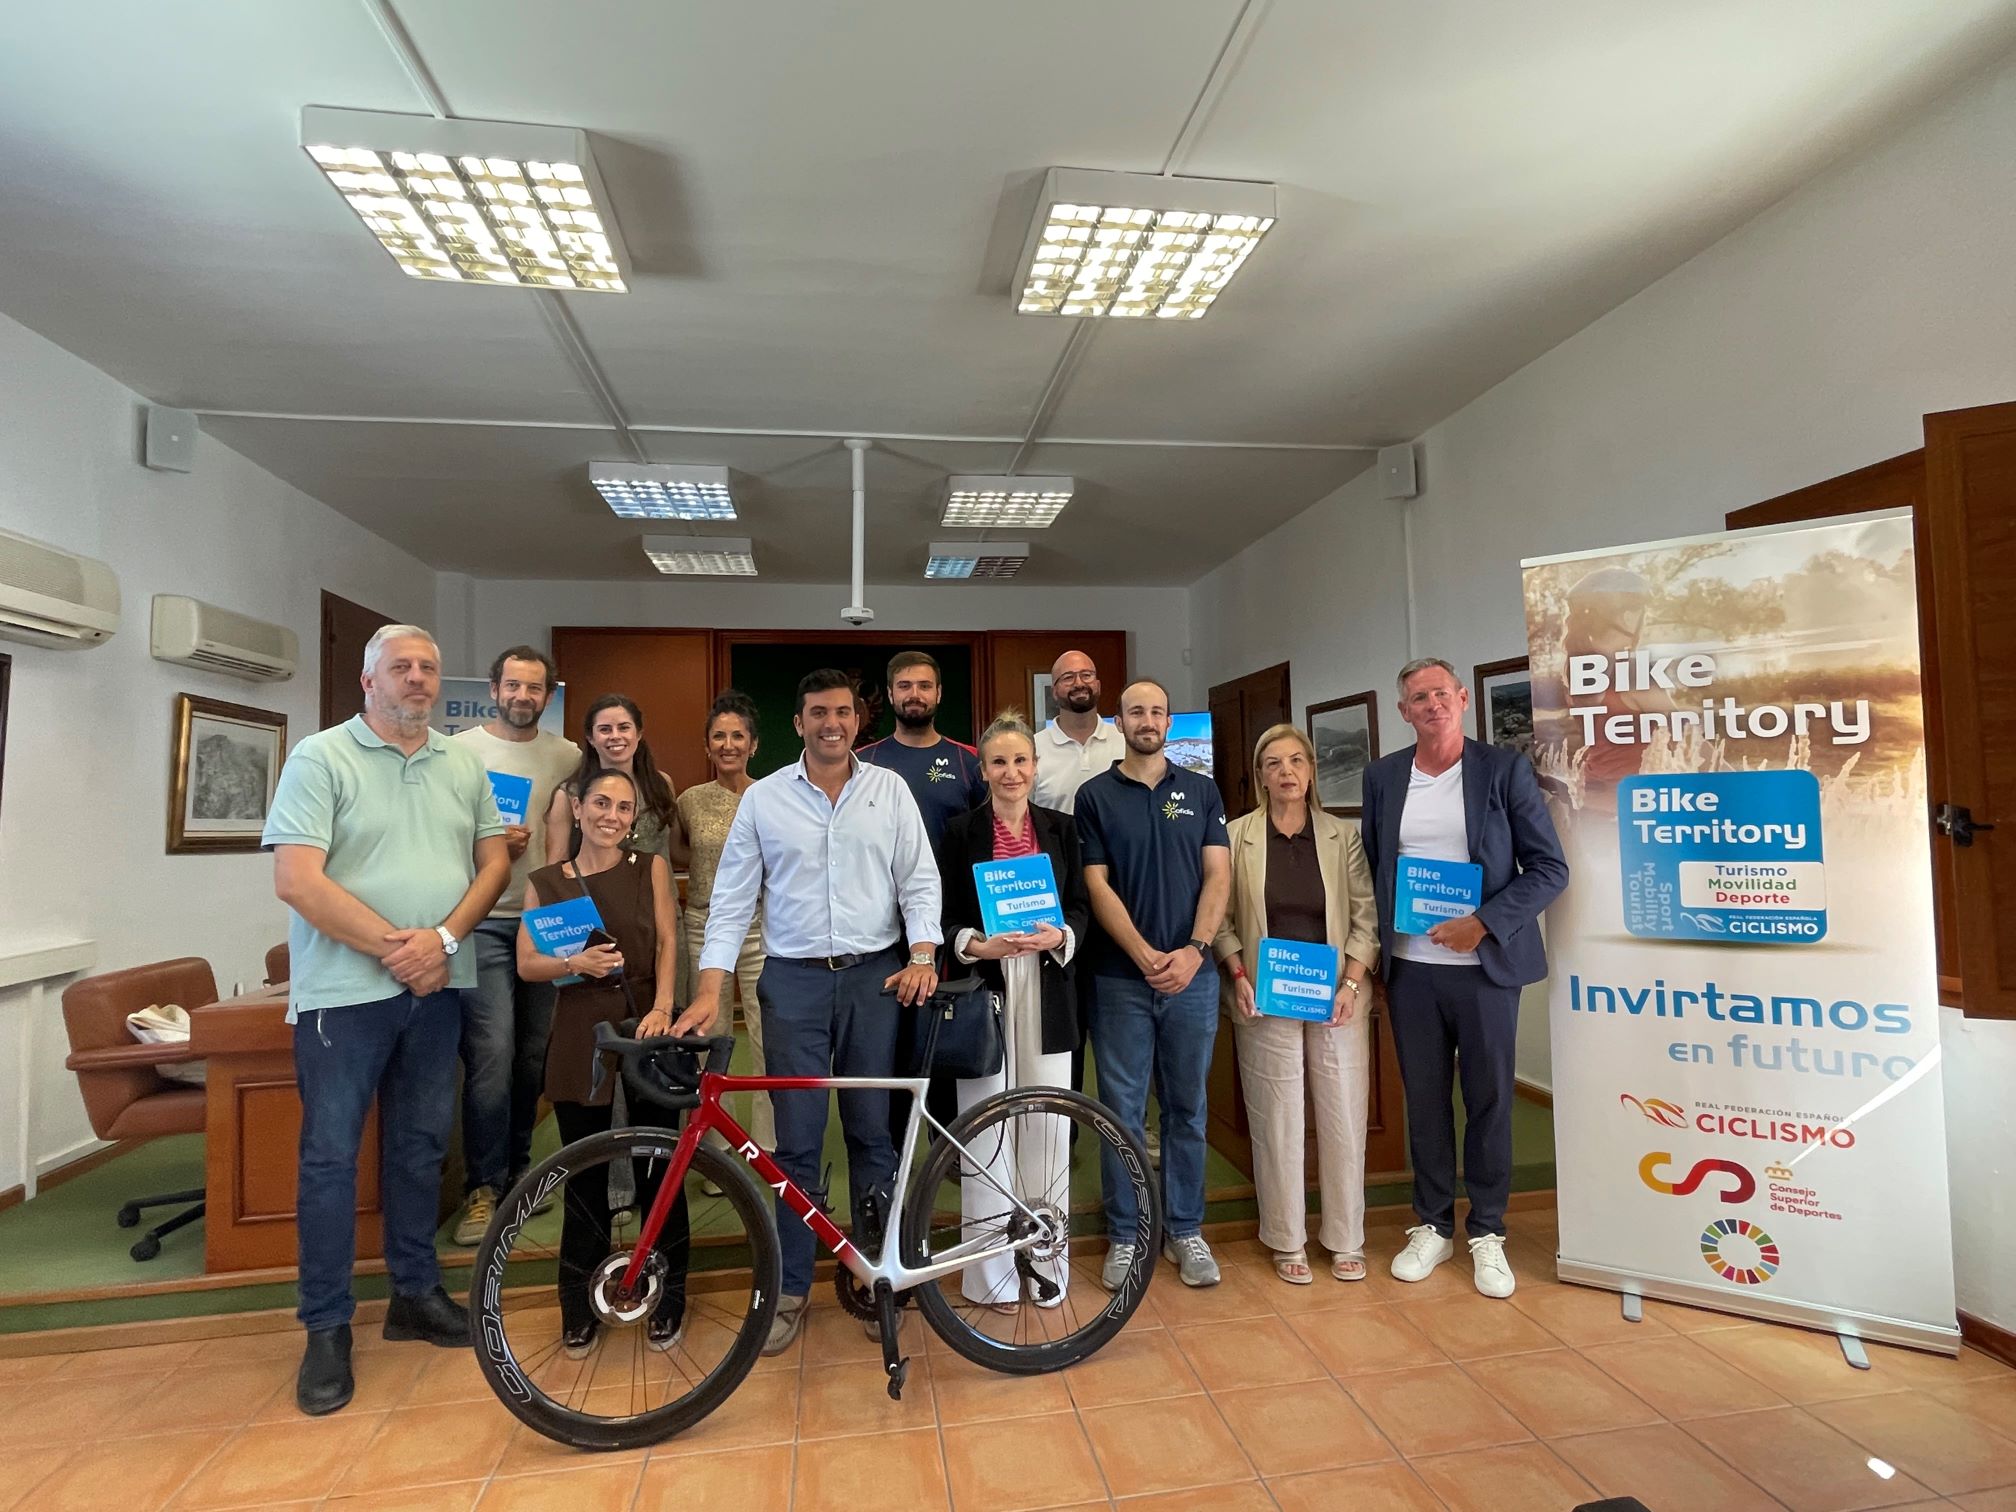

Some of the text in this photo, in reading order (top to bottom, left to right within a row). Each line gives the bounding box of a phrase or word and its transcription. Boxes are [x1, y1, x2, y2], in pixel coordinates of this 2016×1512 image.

[1569, 650, 1716, 697] Bike
[446, 700, 498, 719] Bike
[1569, 697, 1871, 748] Territory
[1632, 788, 1719, 814] Bike
[1633, 818, 1806, 850] Territory
[984, 870, 1016, 883] Bike
[1407, 866, 1441, 881] Bike
[1715, 865, 1788, 877] Turismo
[986, 878, 1047, 895] Territory
[1407, 879, 1472, 900] Territory
[1708, 878, 1797, 891] Movilidad
[1006, 899, 1046, 911] Turismo
[1629, 871, 1644, 931] Tourist
[1643, 862, 1657, 932] Mobility
[1716, 892, 1790, 905] Deporte
[1422, 902, 1465, 915] Turismo
[1659, 882, 1674, 932] Sport
[533, 916, 564, 931] Bike
[1729, 922, 1819, 935] CICLISMO
[1268, 947, 1300, 961] Bike
[1268, 961, 1327, 980] Territory
[1282, 983, 1322, 996] Turismo
[1569, 974, 1912, 1035] Invirtamos
[1668, 1034, 1915, 1082] en futuro
[1695, 1101, 1721, 1110] REAL
[1724, 1103, 1792, 1117] FEDERACIÓN
[1696, 1113, 1856, 1149] CICLISMO
[1768, 1183, 1817, 1198] Consejo
[1769, 1193, 1820, 1208] Superior
[1769, 1203, 1843, 1221] de Deportes
